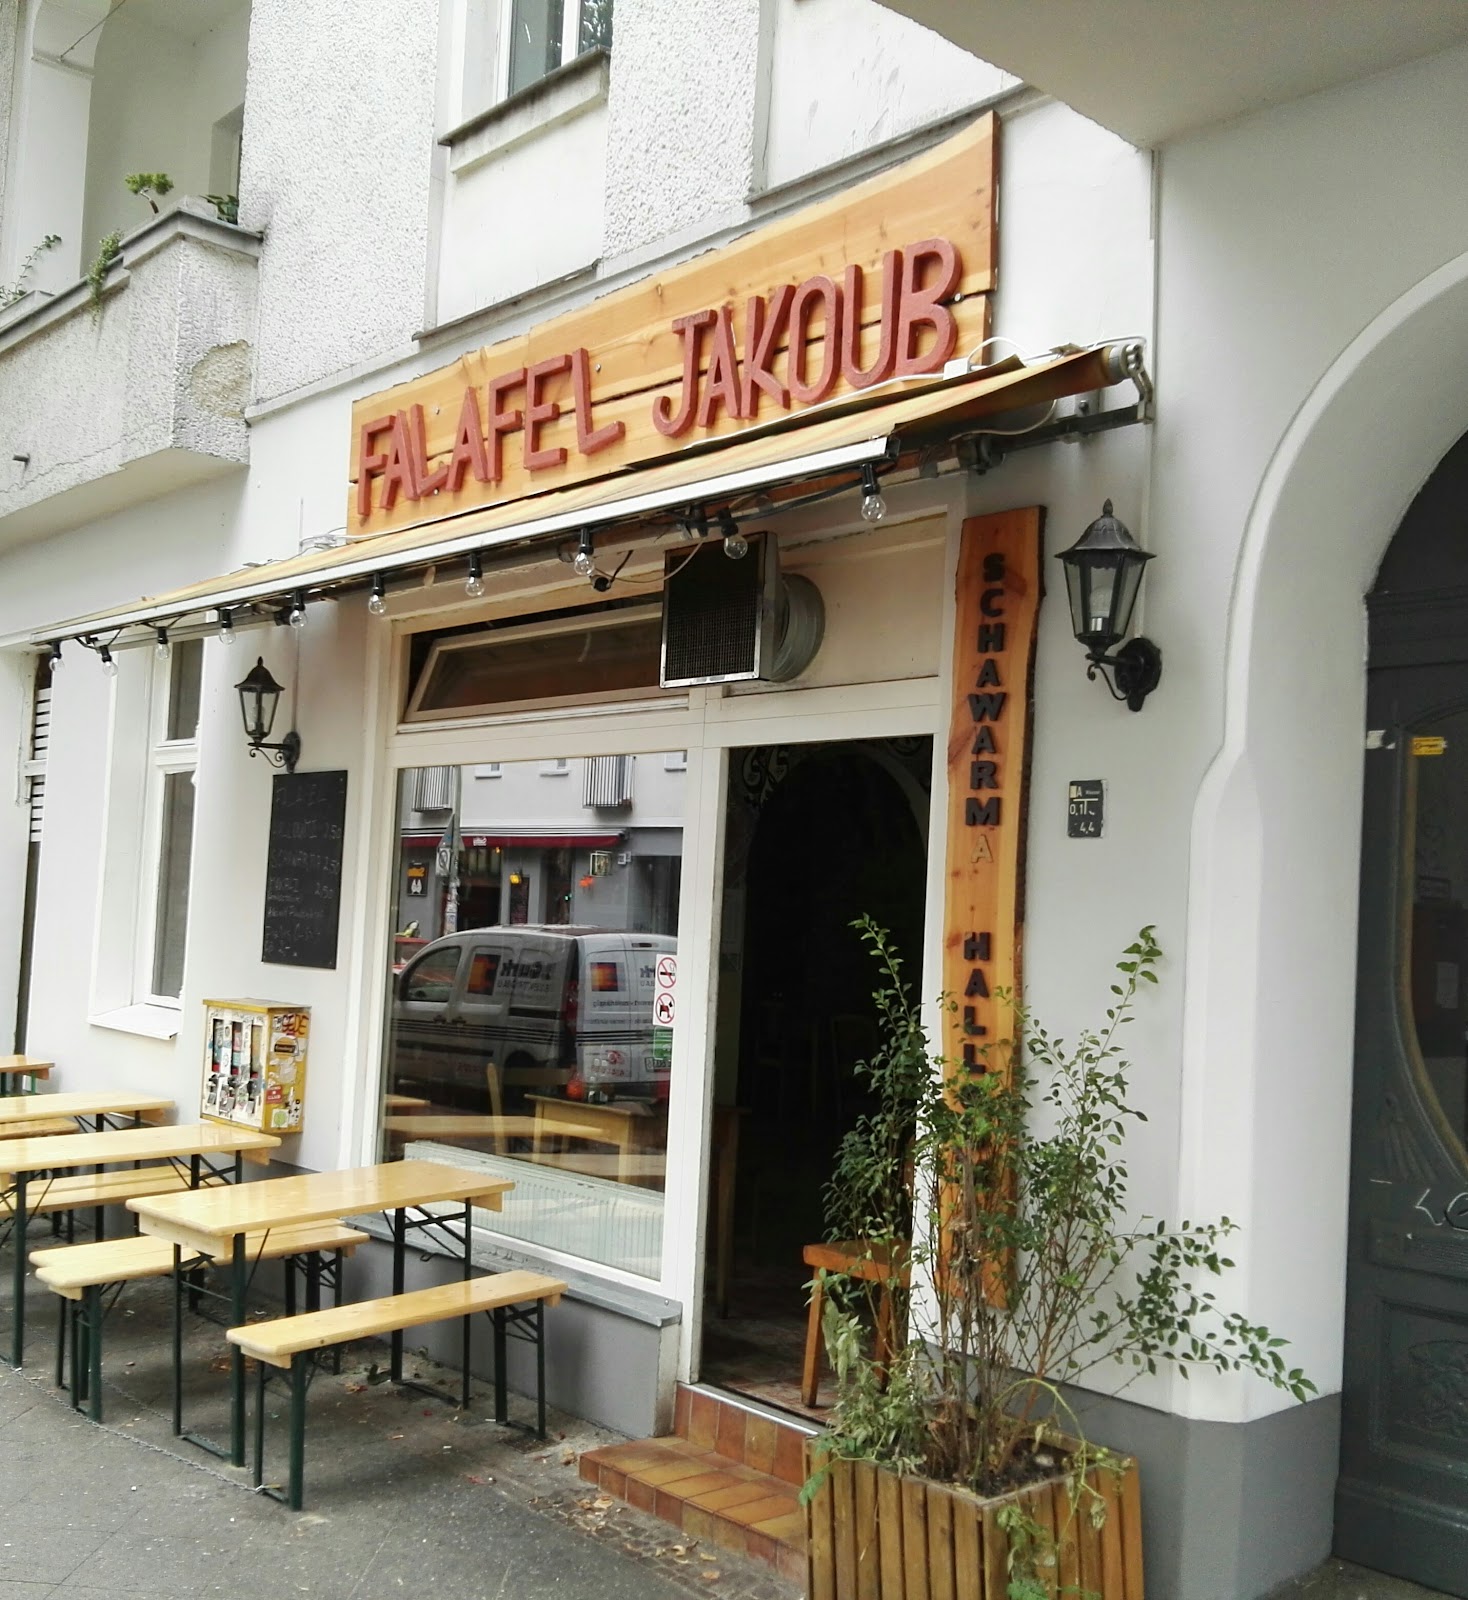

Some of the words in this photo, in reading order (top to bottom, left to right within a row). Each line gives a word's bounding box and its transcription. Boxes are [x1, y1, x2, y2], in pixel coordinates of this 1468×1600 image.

[358, 347, 626, 516] FALAFEL
[652, 238, 963, 438] JAKOUB
[965, 552, 1007, 864] SCHAWARMA
